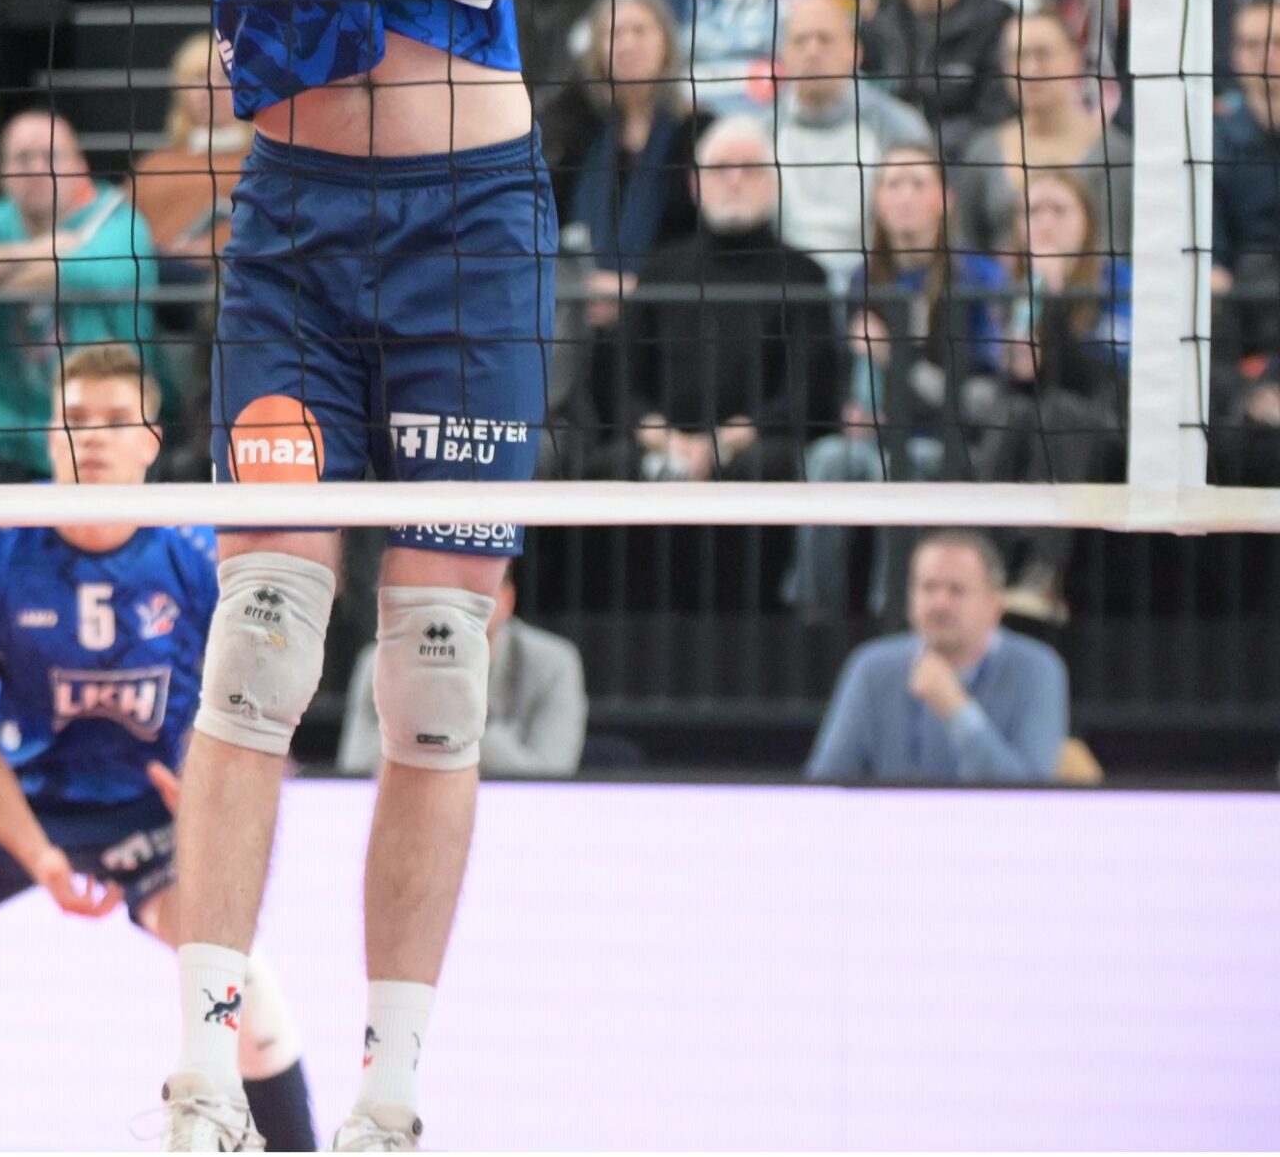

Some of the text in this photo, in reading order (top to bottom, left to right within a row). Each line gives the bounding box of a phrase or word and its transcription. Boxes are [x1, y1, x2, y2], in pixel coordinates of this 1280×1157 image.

[445, 416, 528, 443] MEYER
[237, 437, 318, 466] maz
[442, 440, 496, 465] BAU
